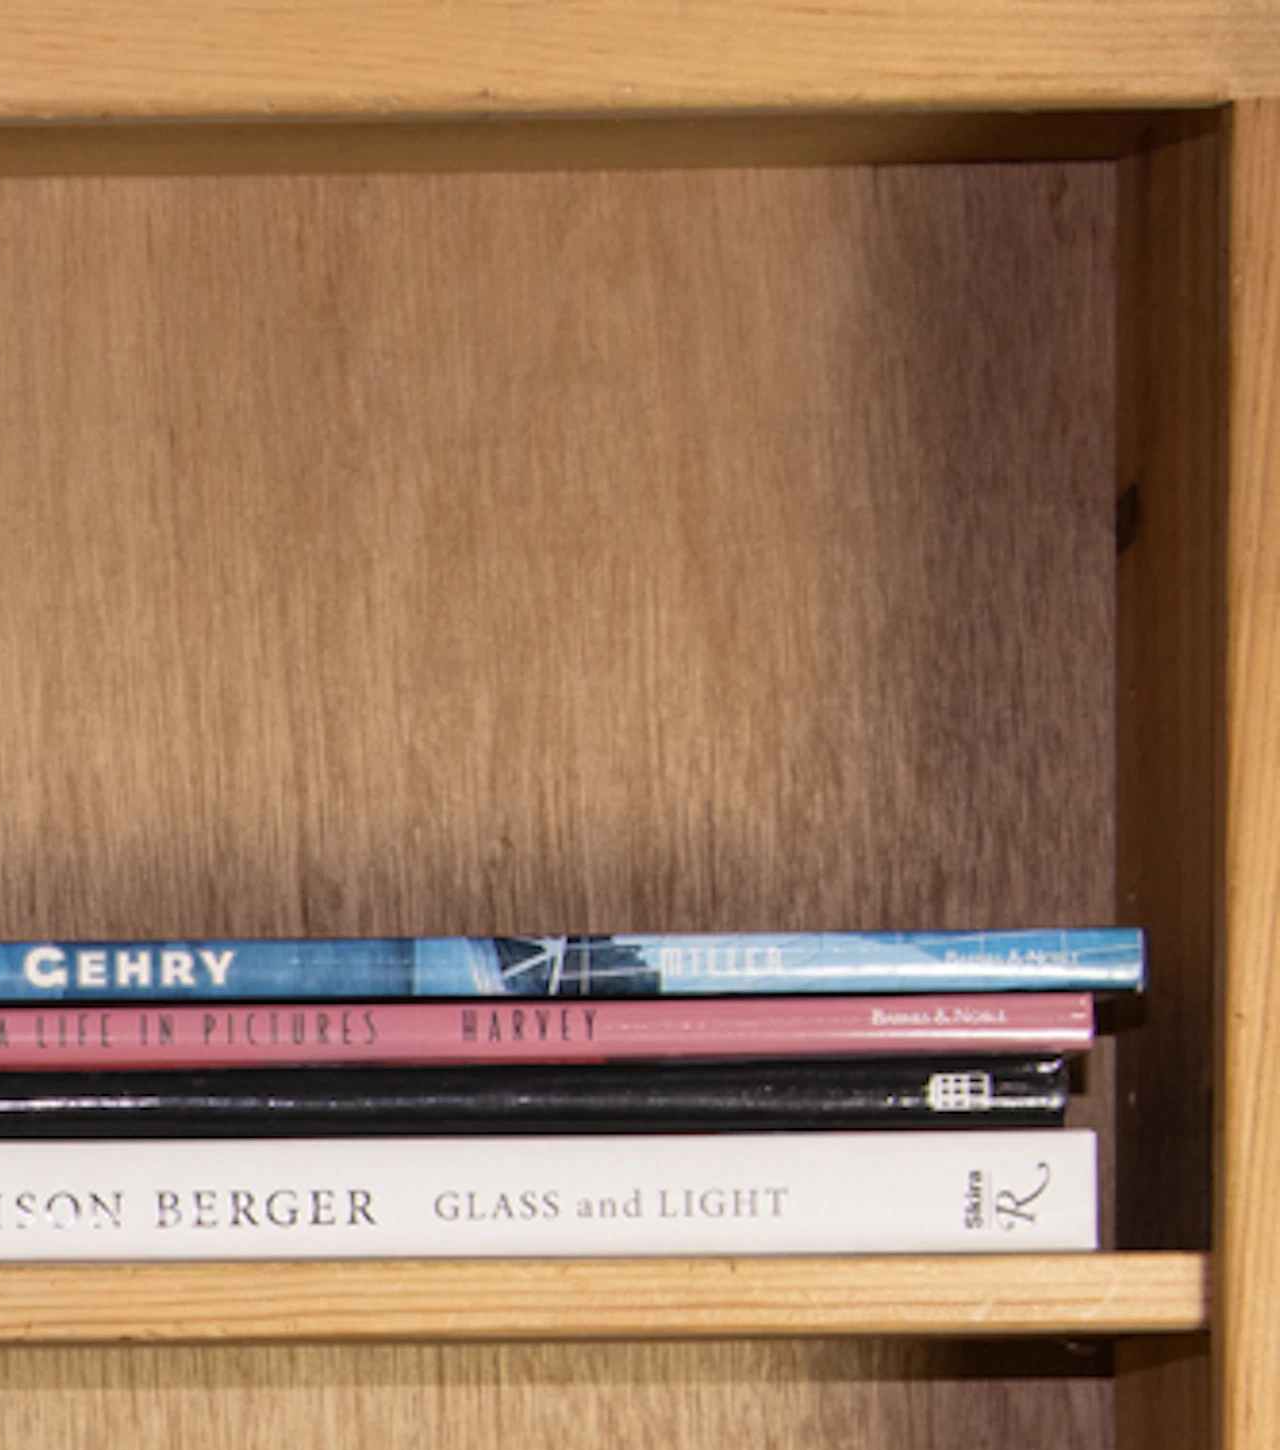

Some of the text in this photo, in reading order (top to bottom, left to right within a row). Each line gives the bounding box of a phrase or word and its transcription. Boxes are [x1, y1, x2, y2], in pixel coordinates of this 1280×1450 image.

[22, 948, 238, 989] GEHRY
[40, 1017, 113, 1049] LIFE
[142, 1015, 172, 1047] IN
[203, 1011, 379, 1046] PICTURES
[461, 1009, 599, 1043] HARVEY
[155, 1188, 376, 1229] BERGER
[434, 1190, 561, 1222] GLASS
[576, 1189, 643, 1219] and
[657, 1187, 789, 1219] LIGHT
[965, 1168, 984, 1230] Skira
